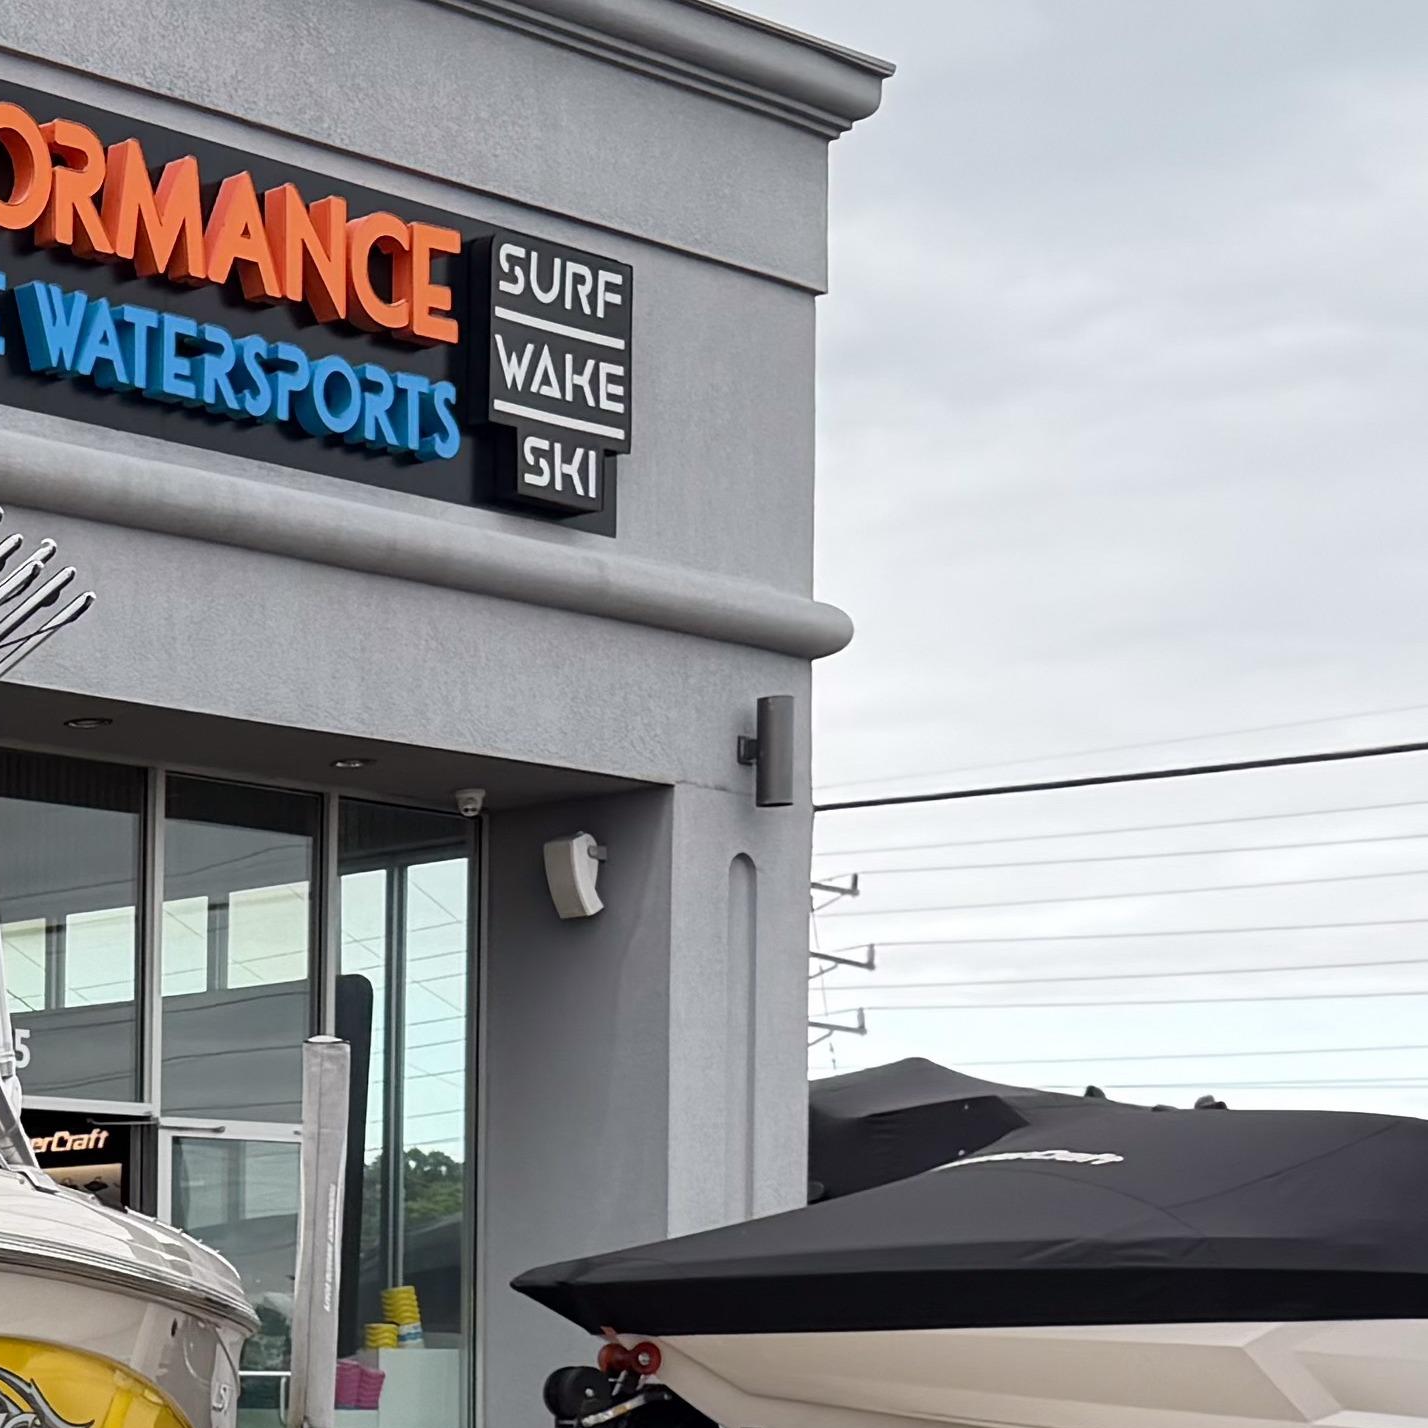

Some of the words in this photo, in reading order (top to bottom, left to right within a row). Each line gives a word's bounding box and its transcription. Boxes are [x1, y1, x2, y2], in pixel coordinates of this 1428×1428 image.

[498, 243, 623, 318] SURF
[15, 279, 461, 460] WATERSPORTS
[494, 333, 624, 413] WAKE
[523, 436, 597, 498] SKI
[30, 1128, 110, 1153] erCraft
